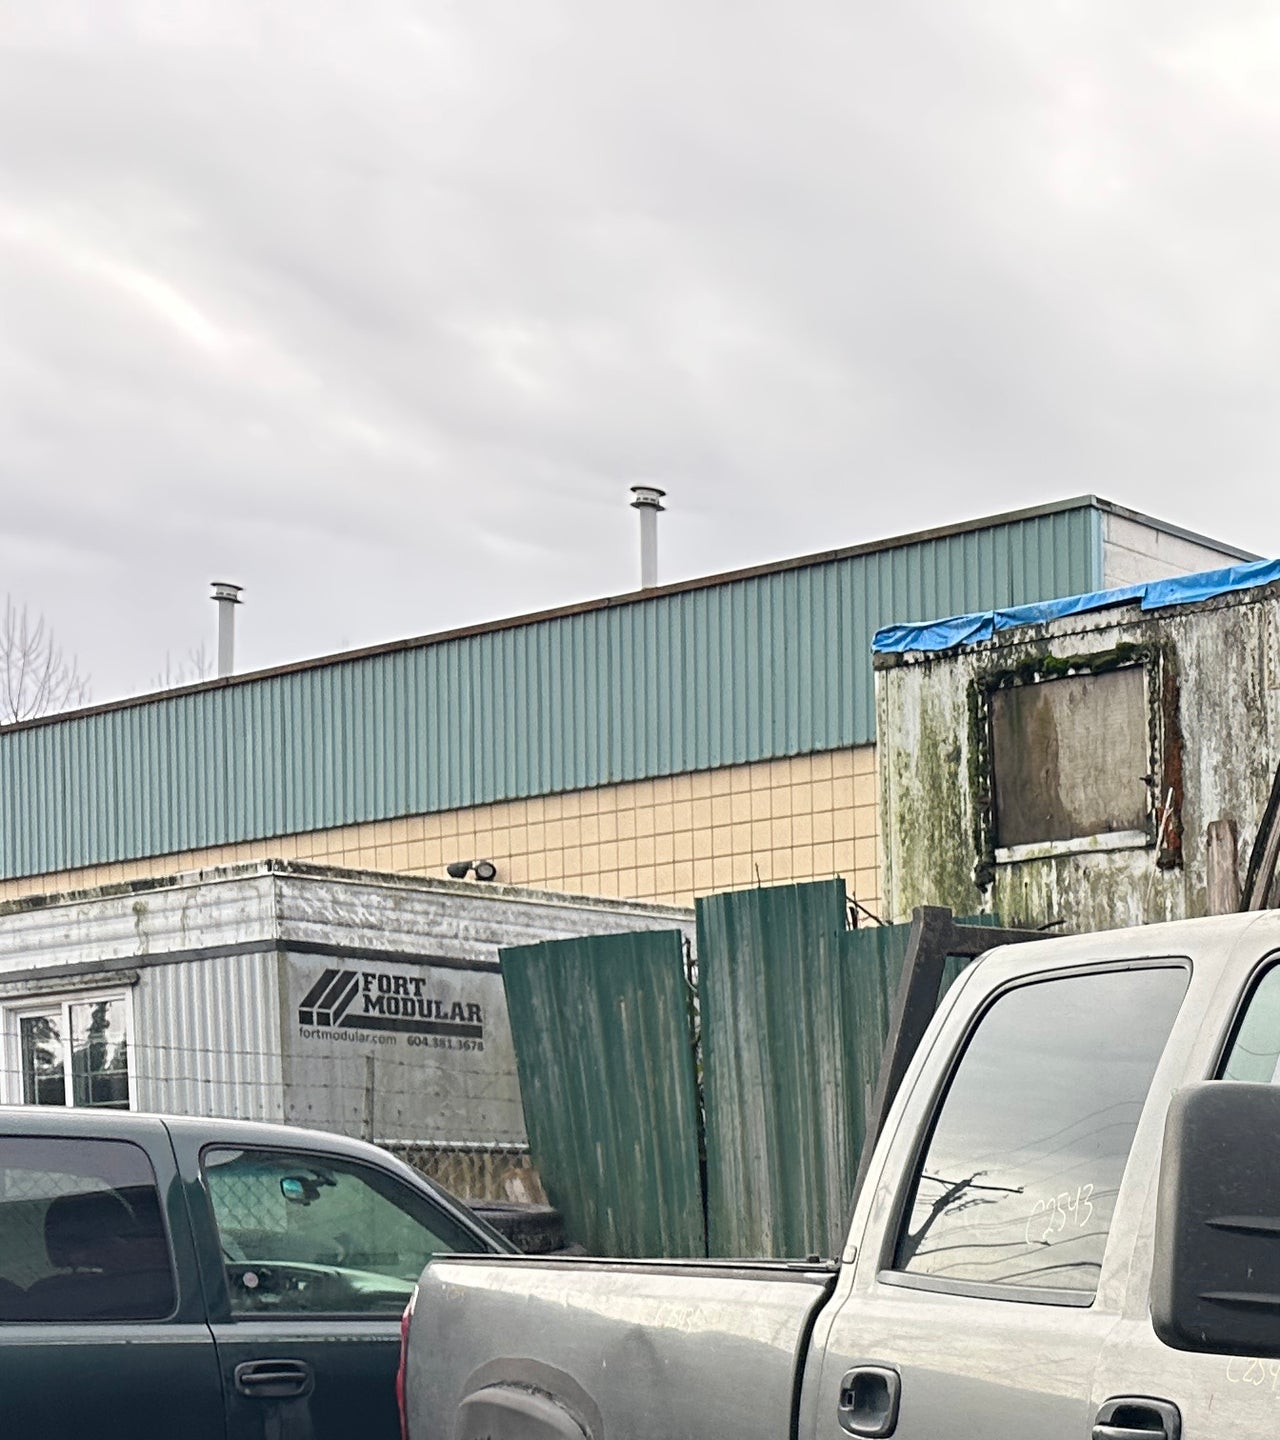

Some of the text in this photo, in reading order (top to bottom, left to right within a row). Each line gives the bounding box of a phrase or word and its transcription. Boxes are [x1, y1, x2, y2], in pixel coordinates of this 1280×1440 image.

[362, 973, 426, 998] FORT
[363, 994, 483, 1023] MODULAR
[299, 1026, 397, 1045] fortmodular.com
[1025, 1183, 1094, 1245] C2543
